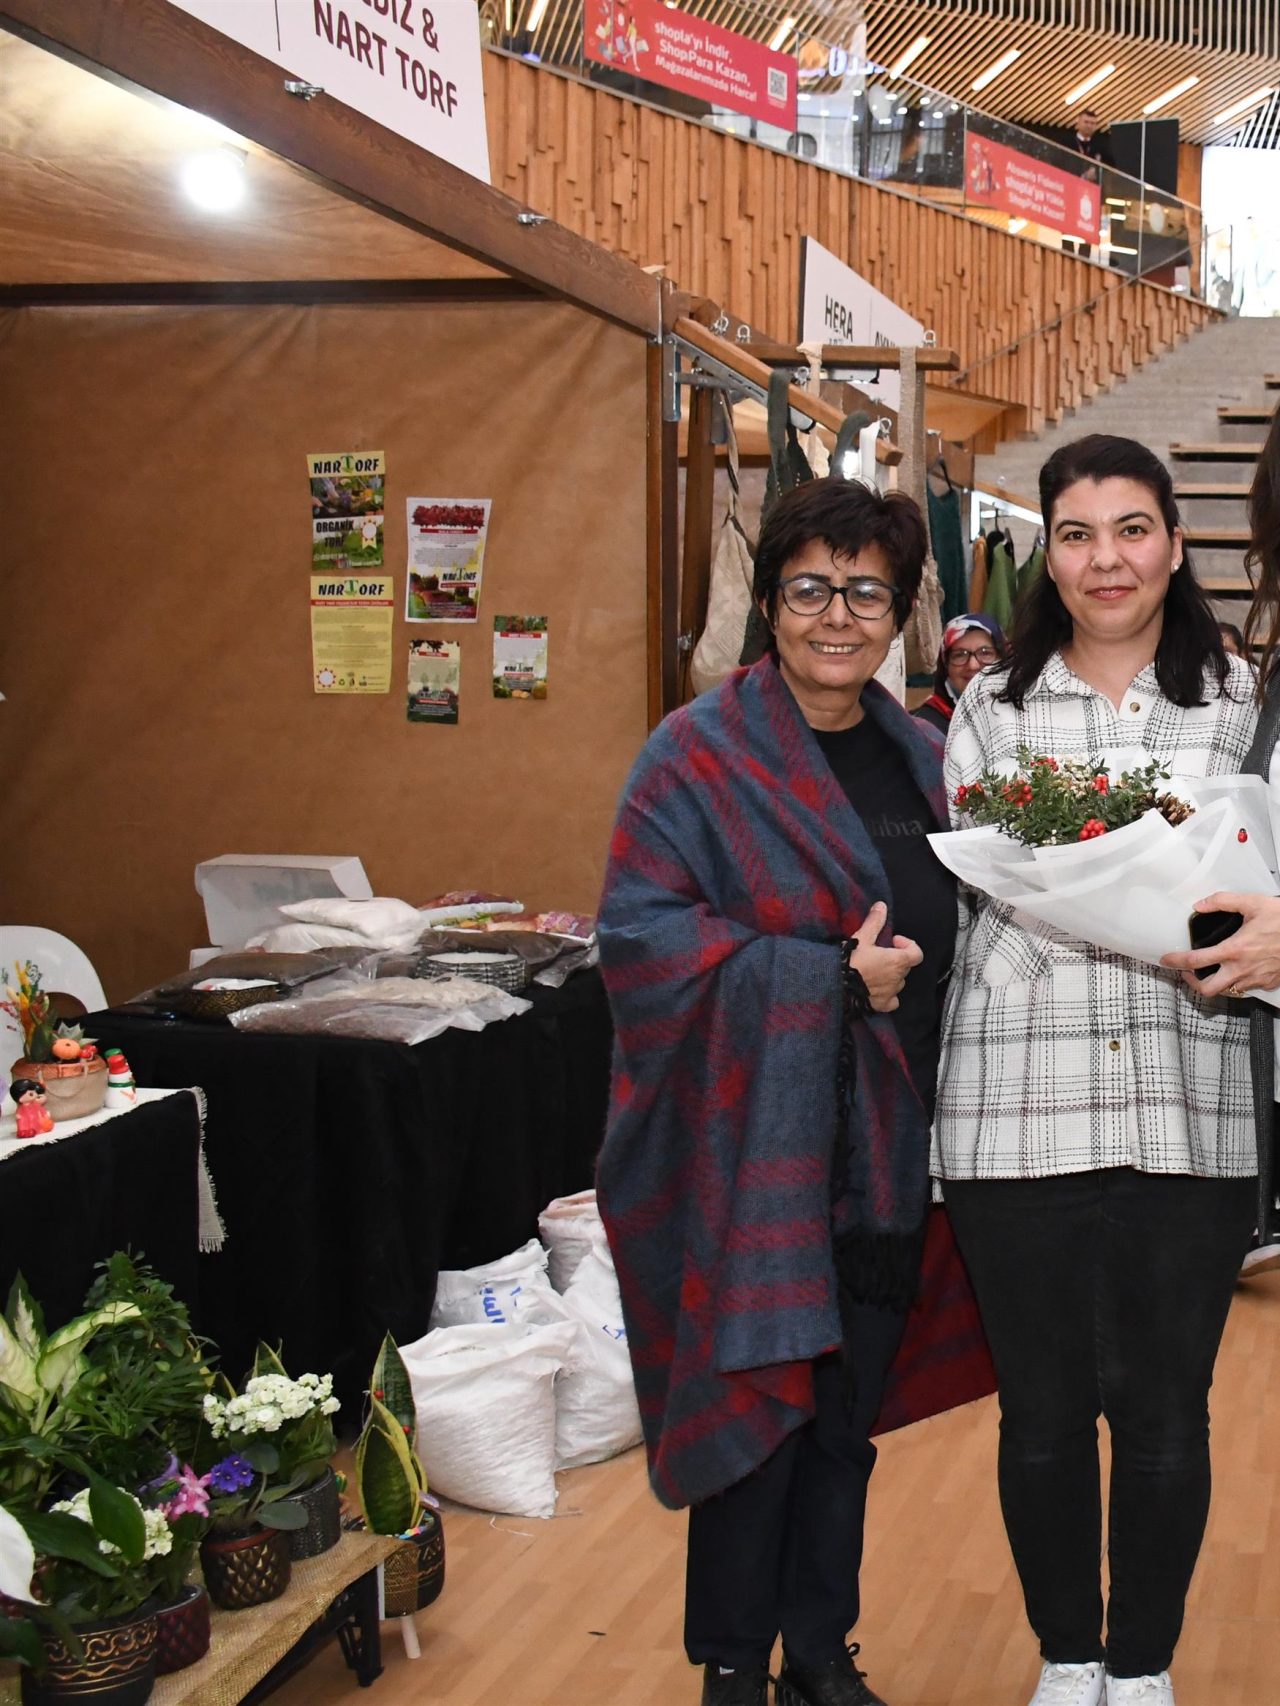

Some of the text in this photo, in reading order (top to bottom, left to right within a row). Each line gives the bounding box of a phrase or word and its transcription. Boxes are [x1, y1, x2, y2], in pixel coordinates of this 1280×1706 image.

[421, 7, 440, 53] &
[313, 0, 458, 118] NART TORF
[824, 294, 853, 342] HERA
